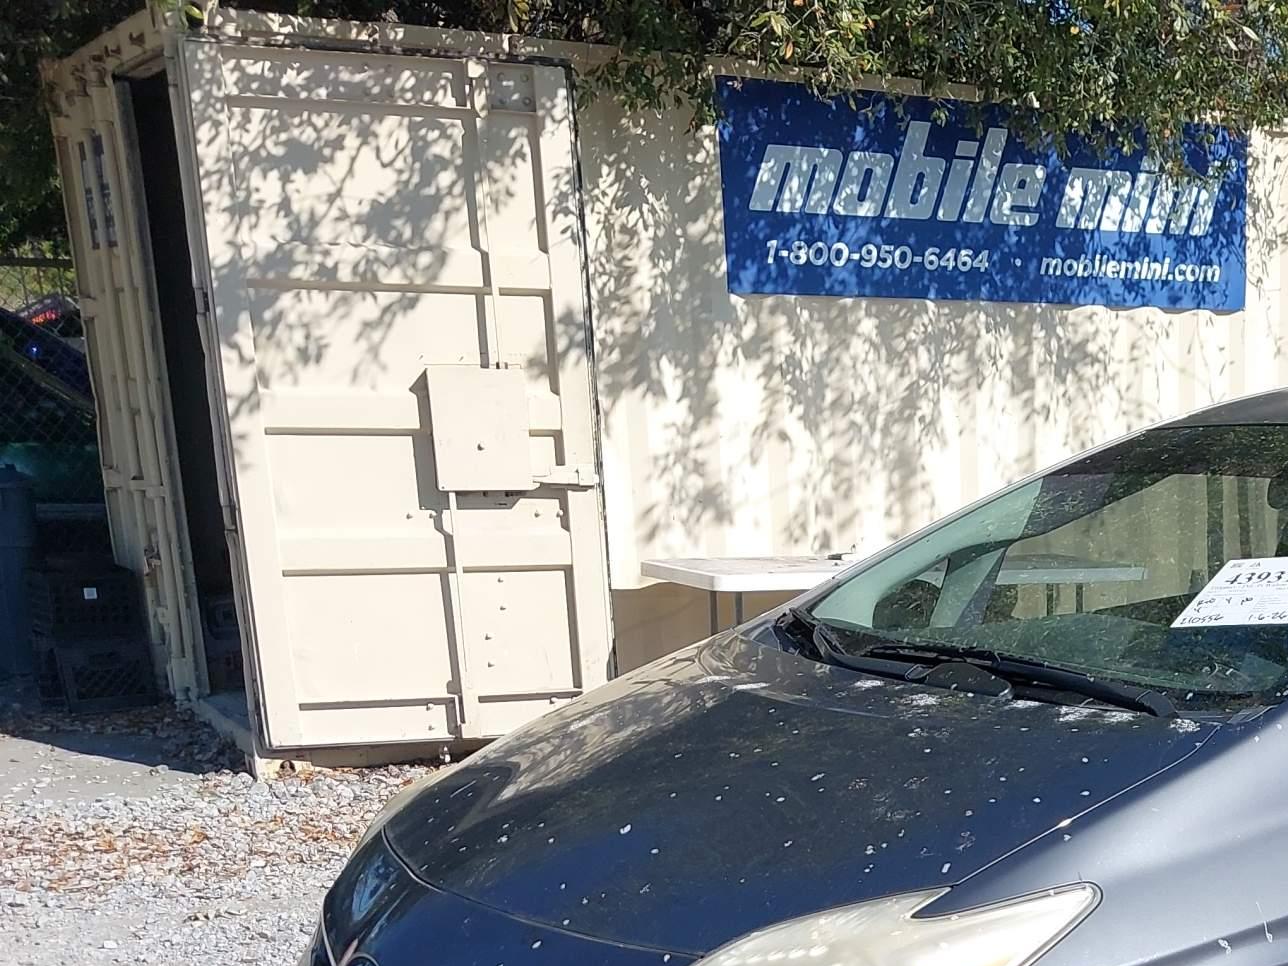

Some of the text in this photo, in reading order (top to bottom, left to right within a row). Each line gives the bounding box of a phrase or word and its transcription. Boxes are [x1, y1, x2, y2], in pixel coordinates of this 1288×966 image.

[748, 120, 1047, 227] mobile
[766, 240, 1221, 282] 1-800-950-6464 mobilemini.com
